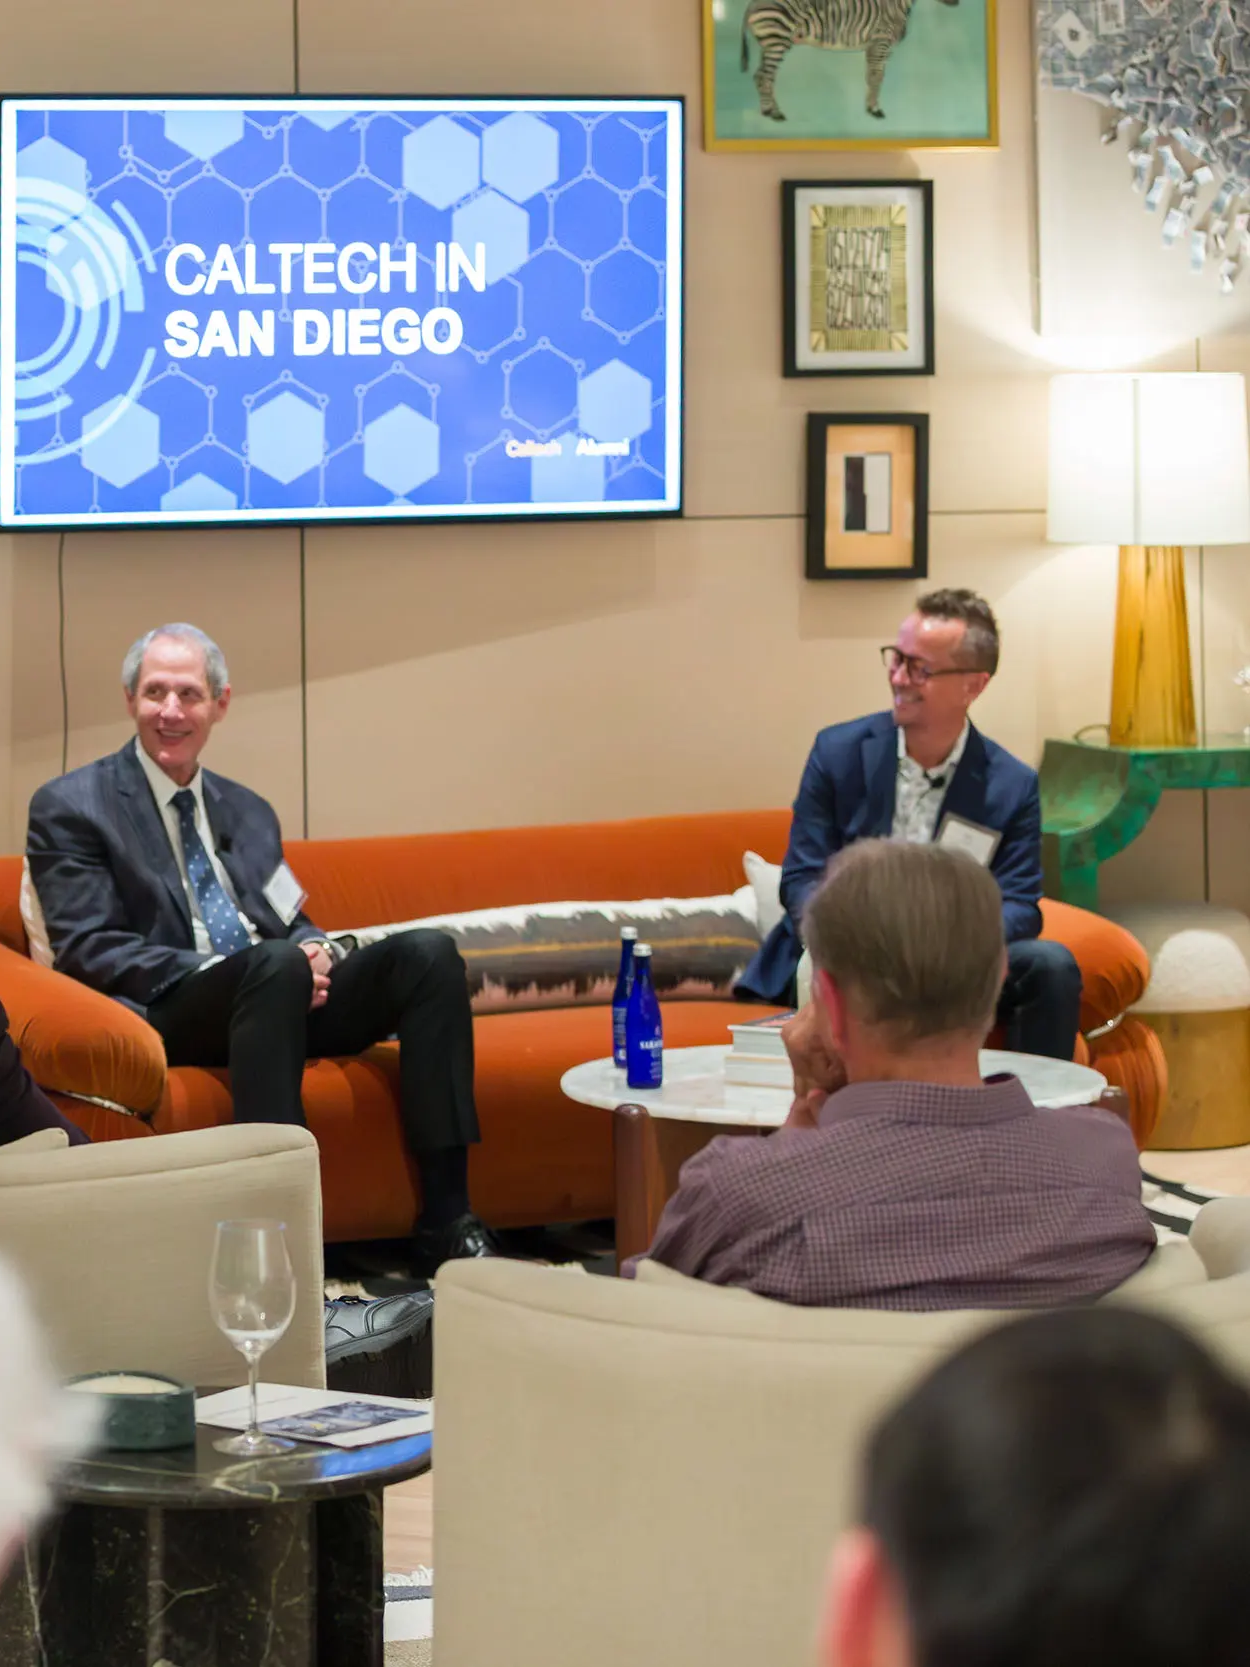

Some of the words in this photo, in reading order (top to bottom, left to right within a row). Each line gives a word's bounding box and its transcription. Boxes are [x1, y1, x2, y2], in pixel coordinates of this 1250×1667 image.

[165, 242, 417, 295] CALTECH
[436, 242, 486, 292] IN
[164, 309, 275, 358] SAN
[293, 307, 463, 355] DIEGO
